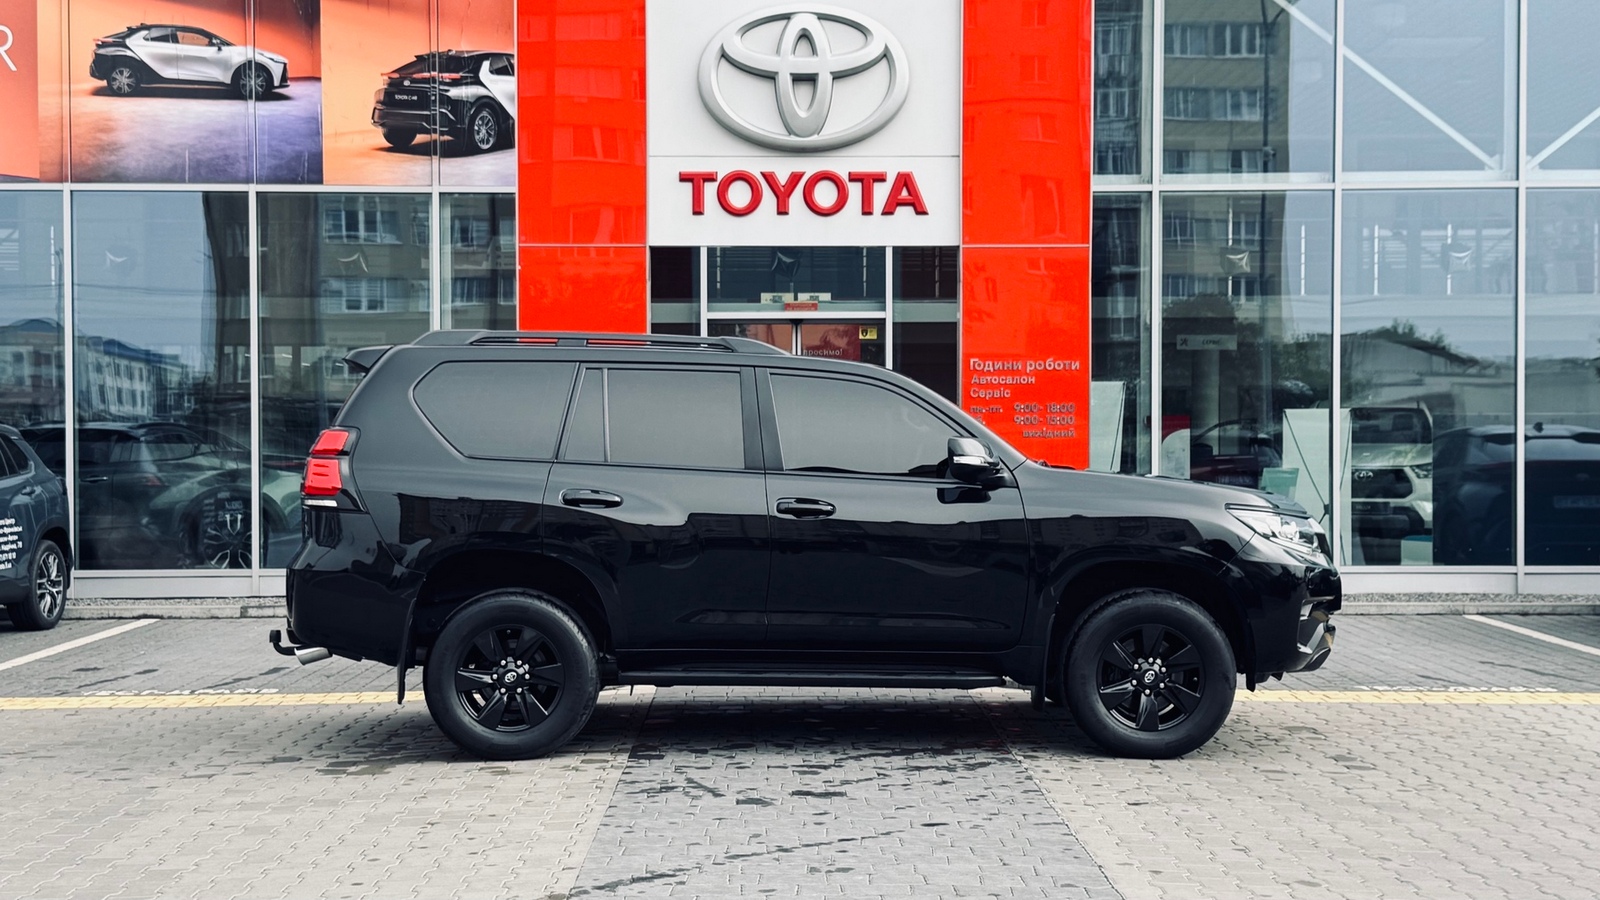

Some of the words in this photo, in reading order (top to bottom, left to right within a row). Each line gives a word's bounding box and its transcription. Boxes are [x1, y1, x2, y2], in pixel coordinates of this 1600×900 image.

[678, 169, 930, 217] TOYOTA
[969, 358, 1022, 372] Години
[1026, 358, 1080, 373] роботи
[971, 375, 1035, 385] Автосалон
[970, 388, 1011, 400] Сервіс
